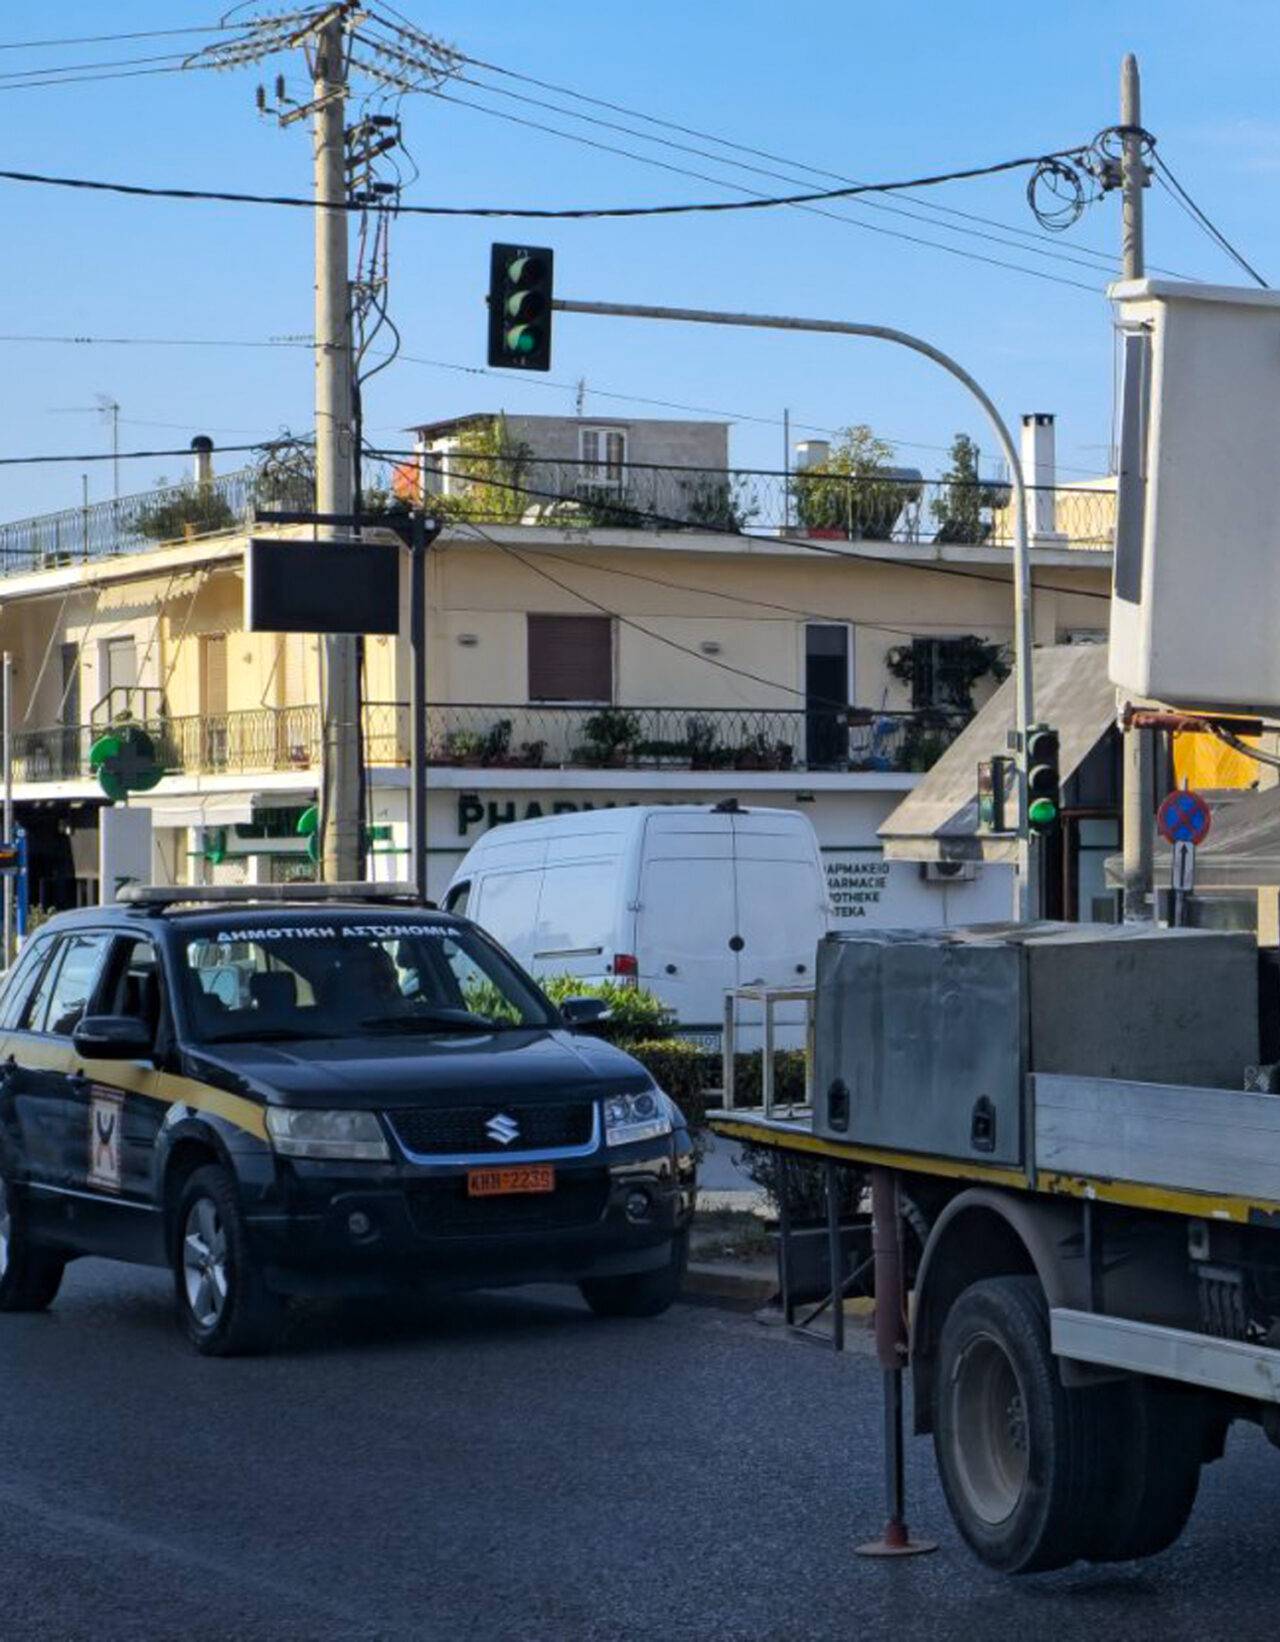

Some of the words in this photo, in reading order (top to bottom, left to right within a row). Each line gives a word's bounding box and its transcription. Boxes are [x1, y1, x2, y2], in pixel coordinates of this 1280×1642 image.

[823, 863, 890, 874] ΑΡΜΑΚΕΙΟ
[217, 926, 335, 943] ΔΗΜΟΤΙΚΗ
[342, 924, 461, 938] ΑΣΤΥΝΟΜΙΑ
